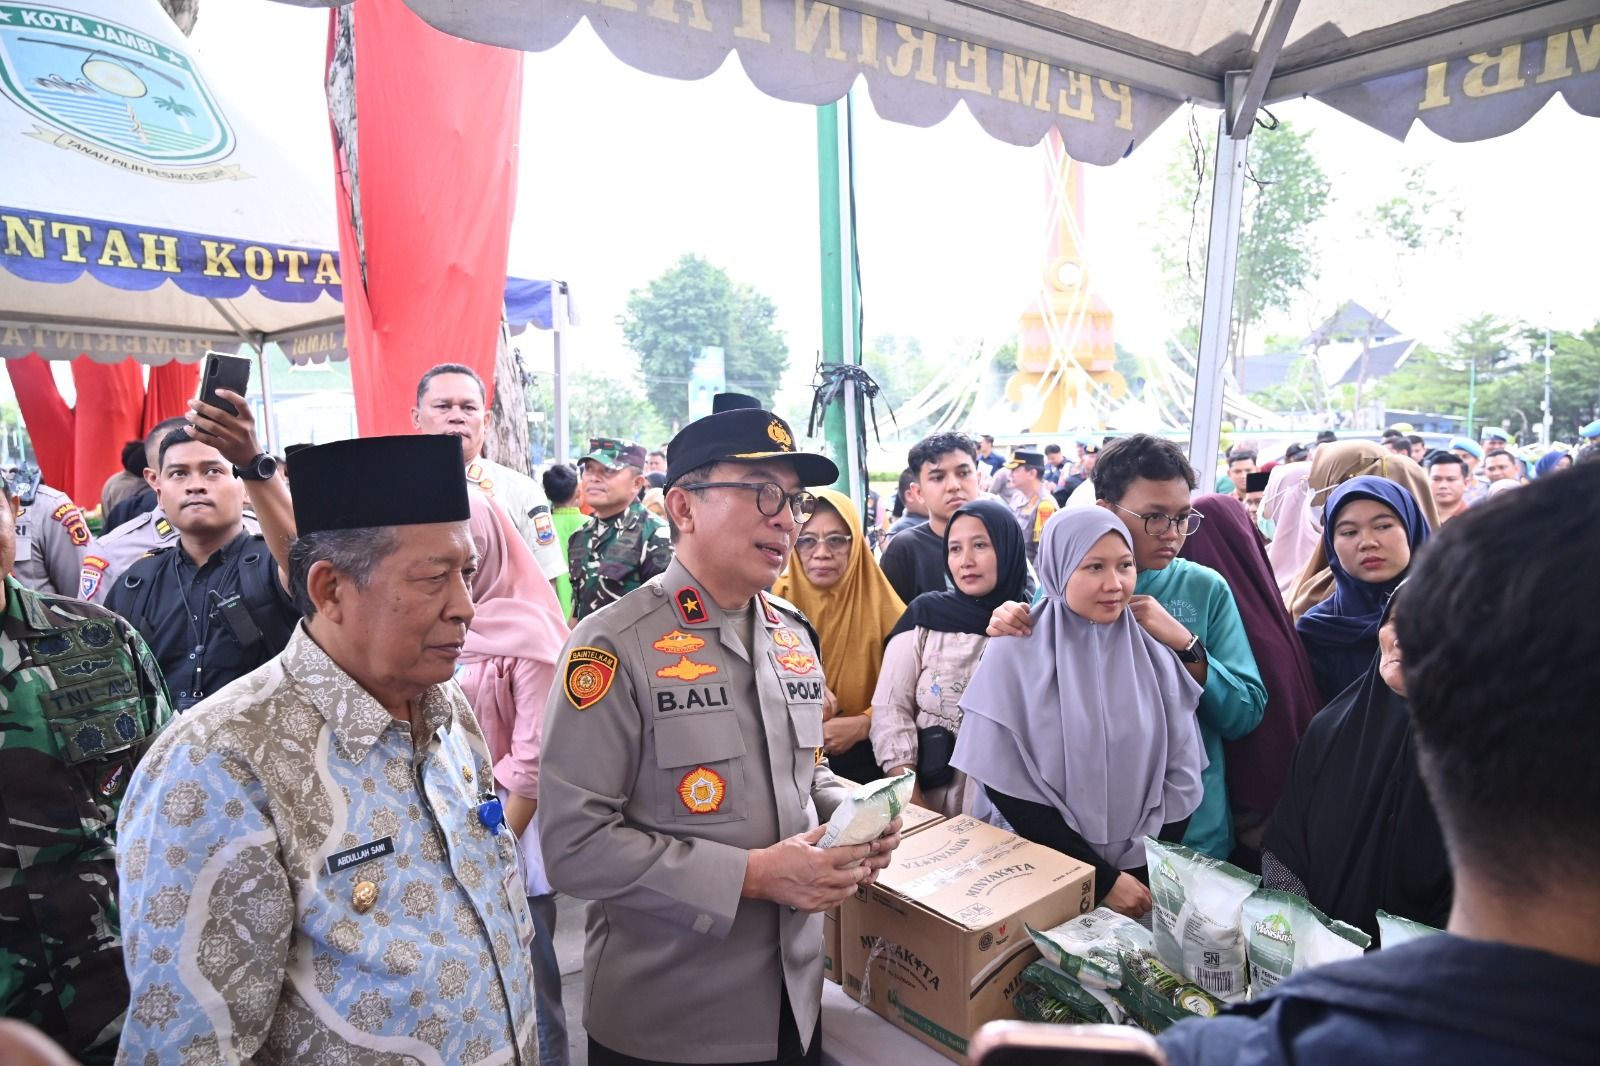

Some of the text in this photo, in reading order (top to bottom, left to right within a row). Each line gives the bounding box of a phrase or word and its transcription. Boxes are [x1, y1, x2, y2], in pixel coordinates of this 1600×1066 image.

[21, 10, 160, 57] KOTA JAMBI
[67, 139, 109, 162] TANAH
[111, 158, 144, 173] PILIH
[1, 215, 342, 285] NTAH KOTA
[1172, 607, 1183, 617] 11
[572, 650, 614, 667] BAINTELKAM
[51, 688, 95, 711] TNI
[656, 686, 729, 713] B.ALI
[786, 681, 822, 700] POLRI
[337, 843, 386, 867] ABDULLAH SANI
[1203, 951, 1220, 966] SNI
